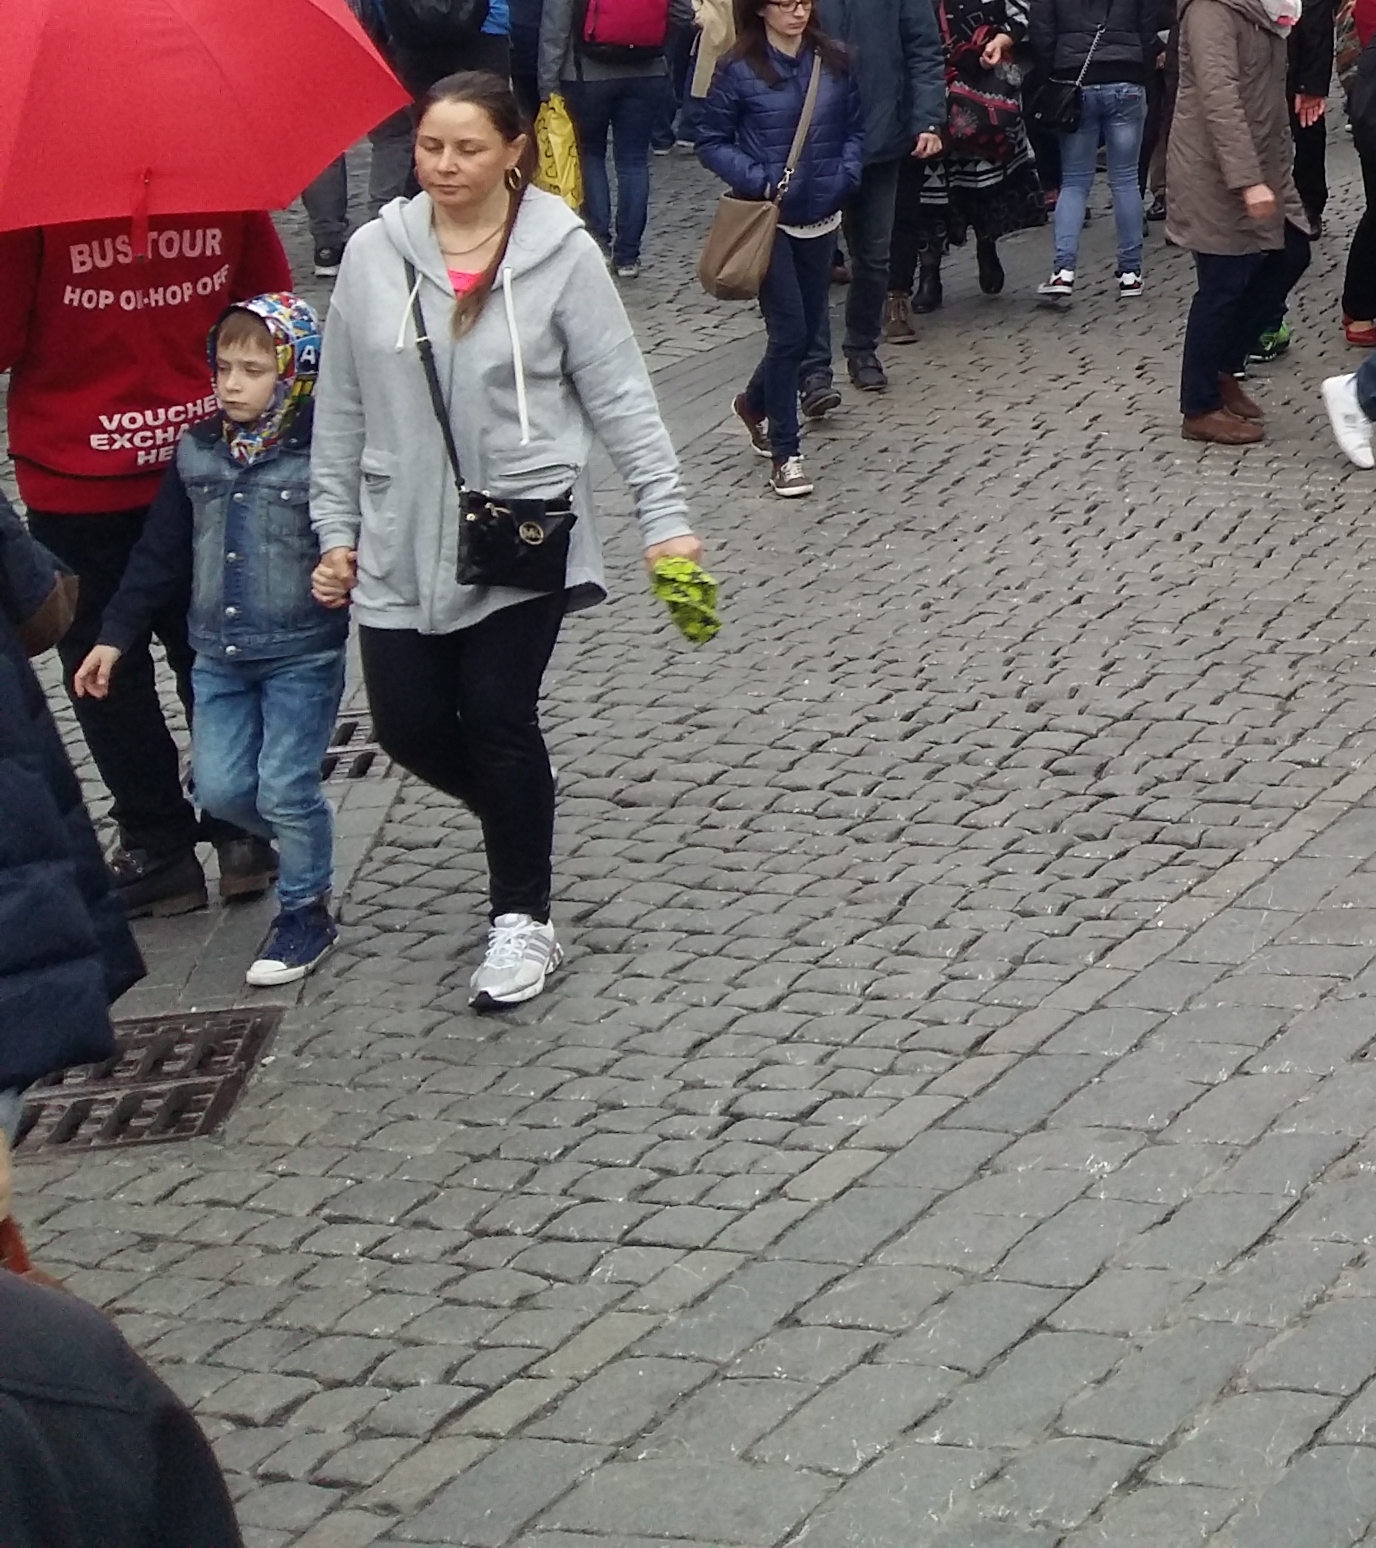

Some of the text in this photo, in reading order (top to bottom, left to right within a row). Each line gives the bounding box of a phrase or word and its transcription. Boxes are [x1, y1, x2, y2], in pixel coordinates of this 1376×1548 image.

[69, 227, 223, 274] BUS TOUR
[63, 285, 115, 310] HOP
[196, 263, 230, 296] OFF
[89, 423, 191, 451] EXCHA
[137, 445, 175, 467] HE
